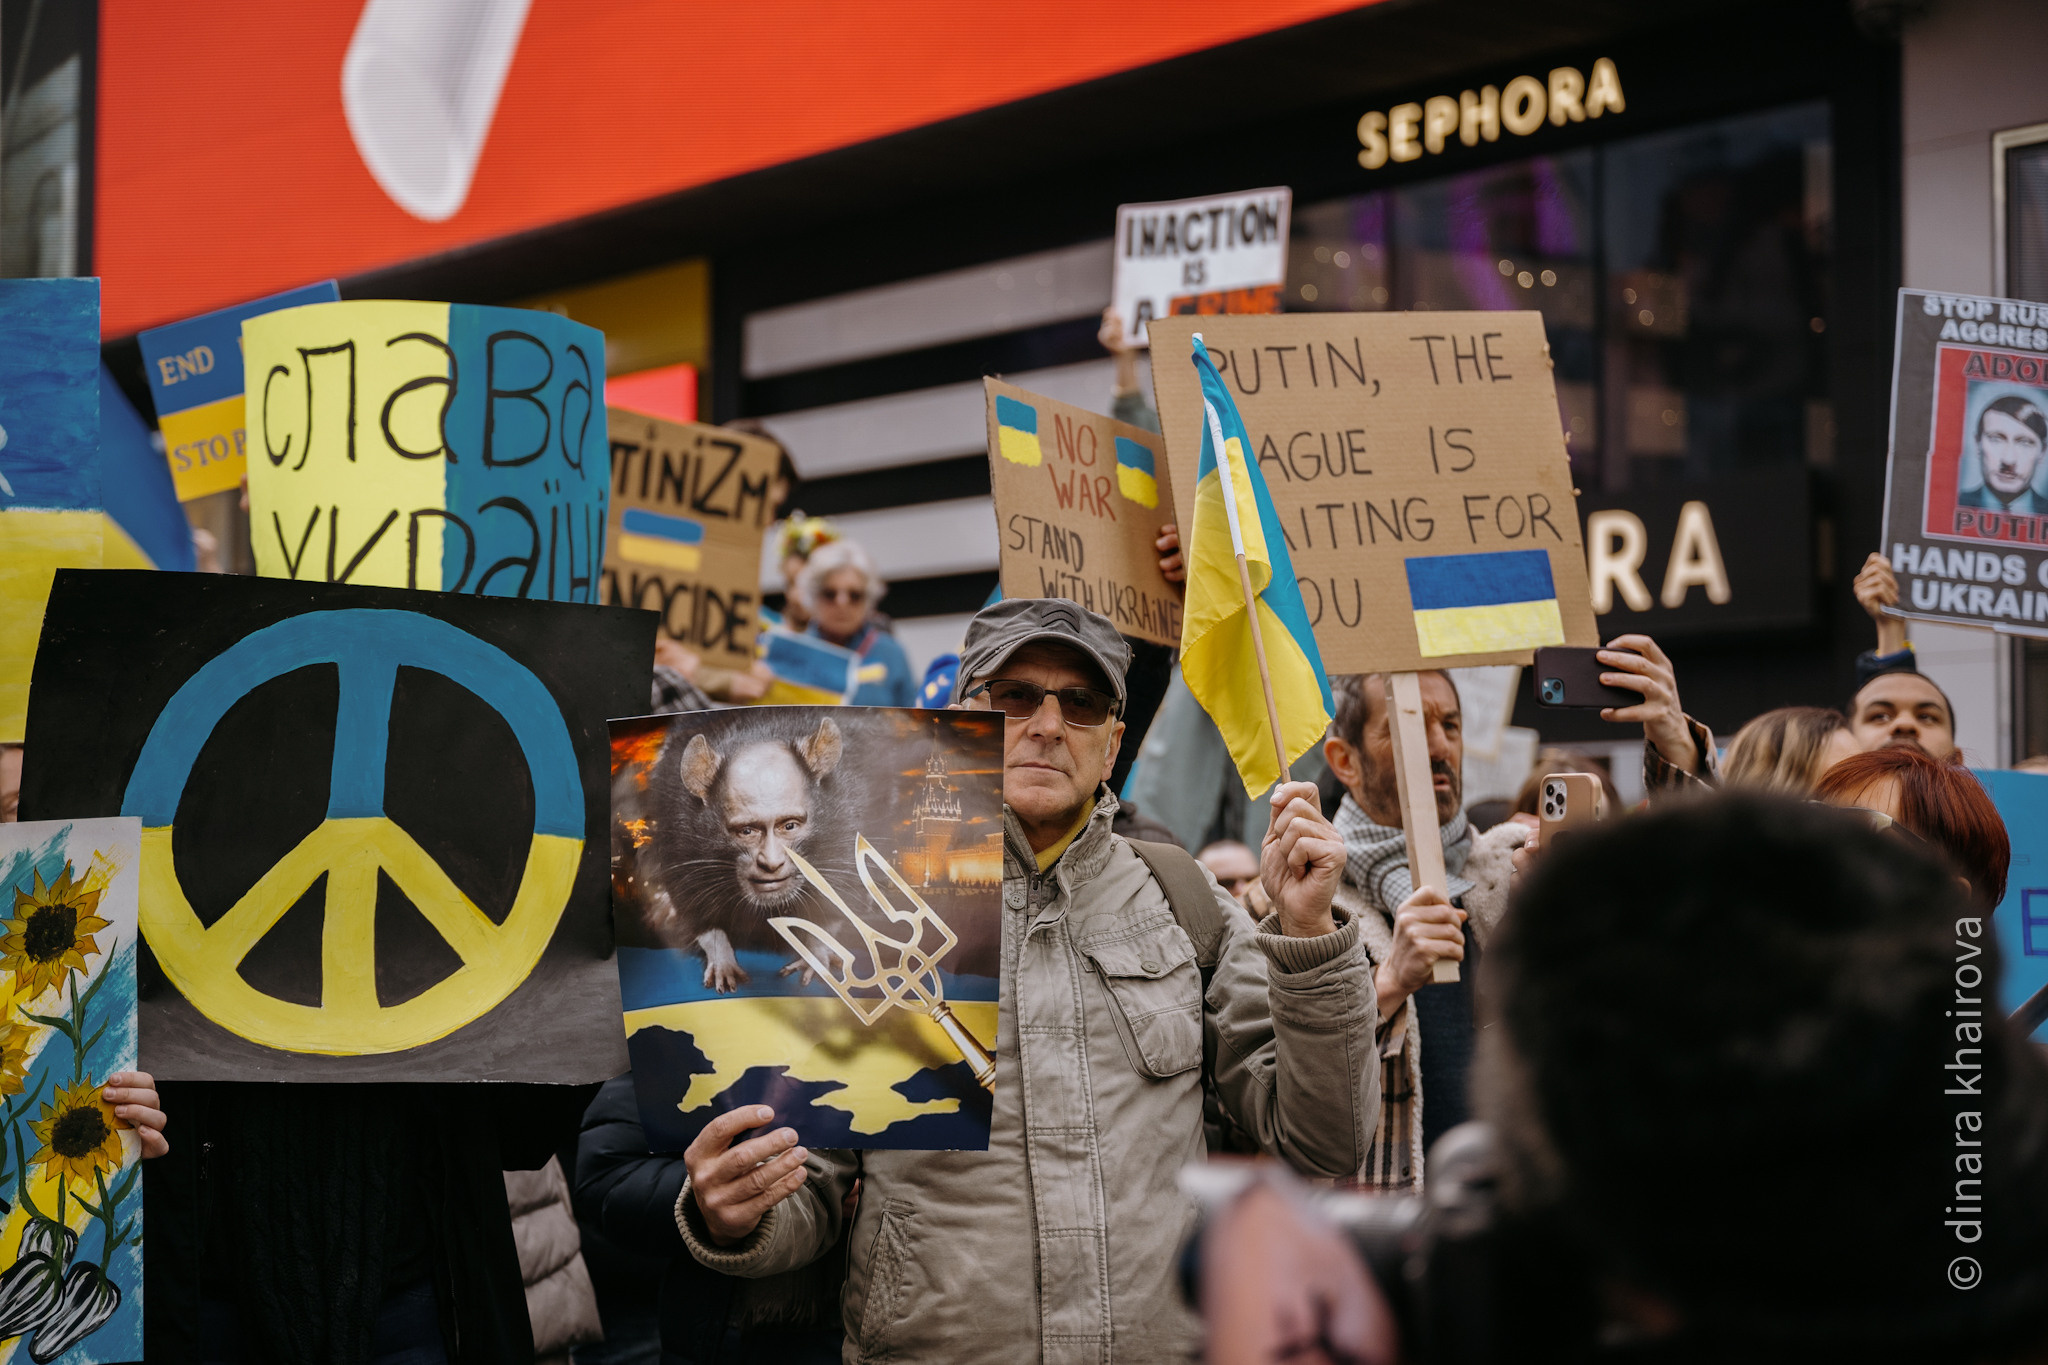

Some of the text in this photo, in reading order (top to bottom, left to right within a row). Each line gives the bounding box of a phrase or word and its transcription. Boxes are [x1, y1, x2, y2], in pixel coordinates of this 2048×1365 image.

[1357, 57, 1626, 170] SEPHORA
[1126, 198, 1281, 257] INACTION
[1182, 257, 1209, 286] IS
[1923, 295, 1994, 322] STOP
[1940, 318, 2048, 351] AGGRES
[157, 345, 214, 386] END
[1410, 333, 1512, 386] THE
[1963, 351, 2048, 382] ADO
[174, 427, 246, 472] STOP
[1054, 413, 1097, 466] NO
[1258, 426, 1476, 482] AGUE IS
[1047, 463, 1116, 522] WAR
[1008, 514, 1084, 573] STAND
[1281, 493, 1562, 551] ITING FOR
[1892, 542, 2027, 586] HANDS
[601, 567, 749, 655] NOCIDE
[1297, 577, 1362, 628] OU
